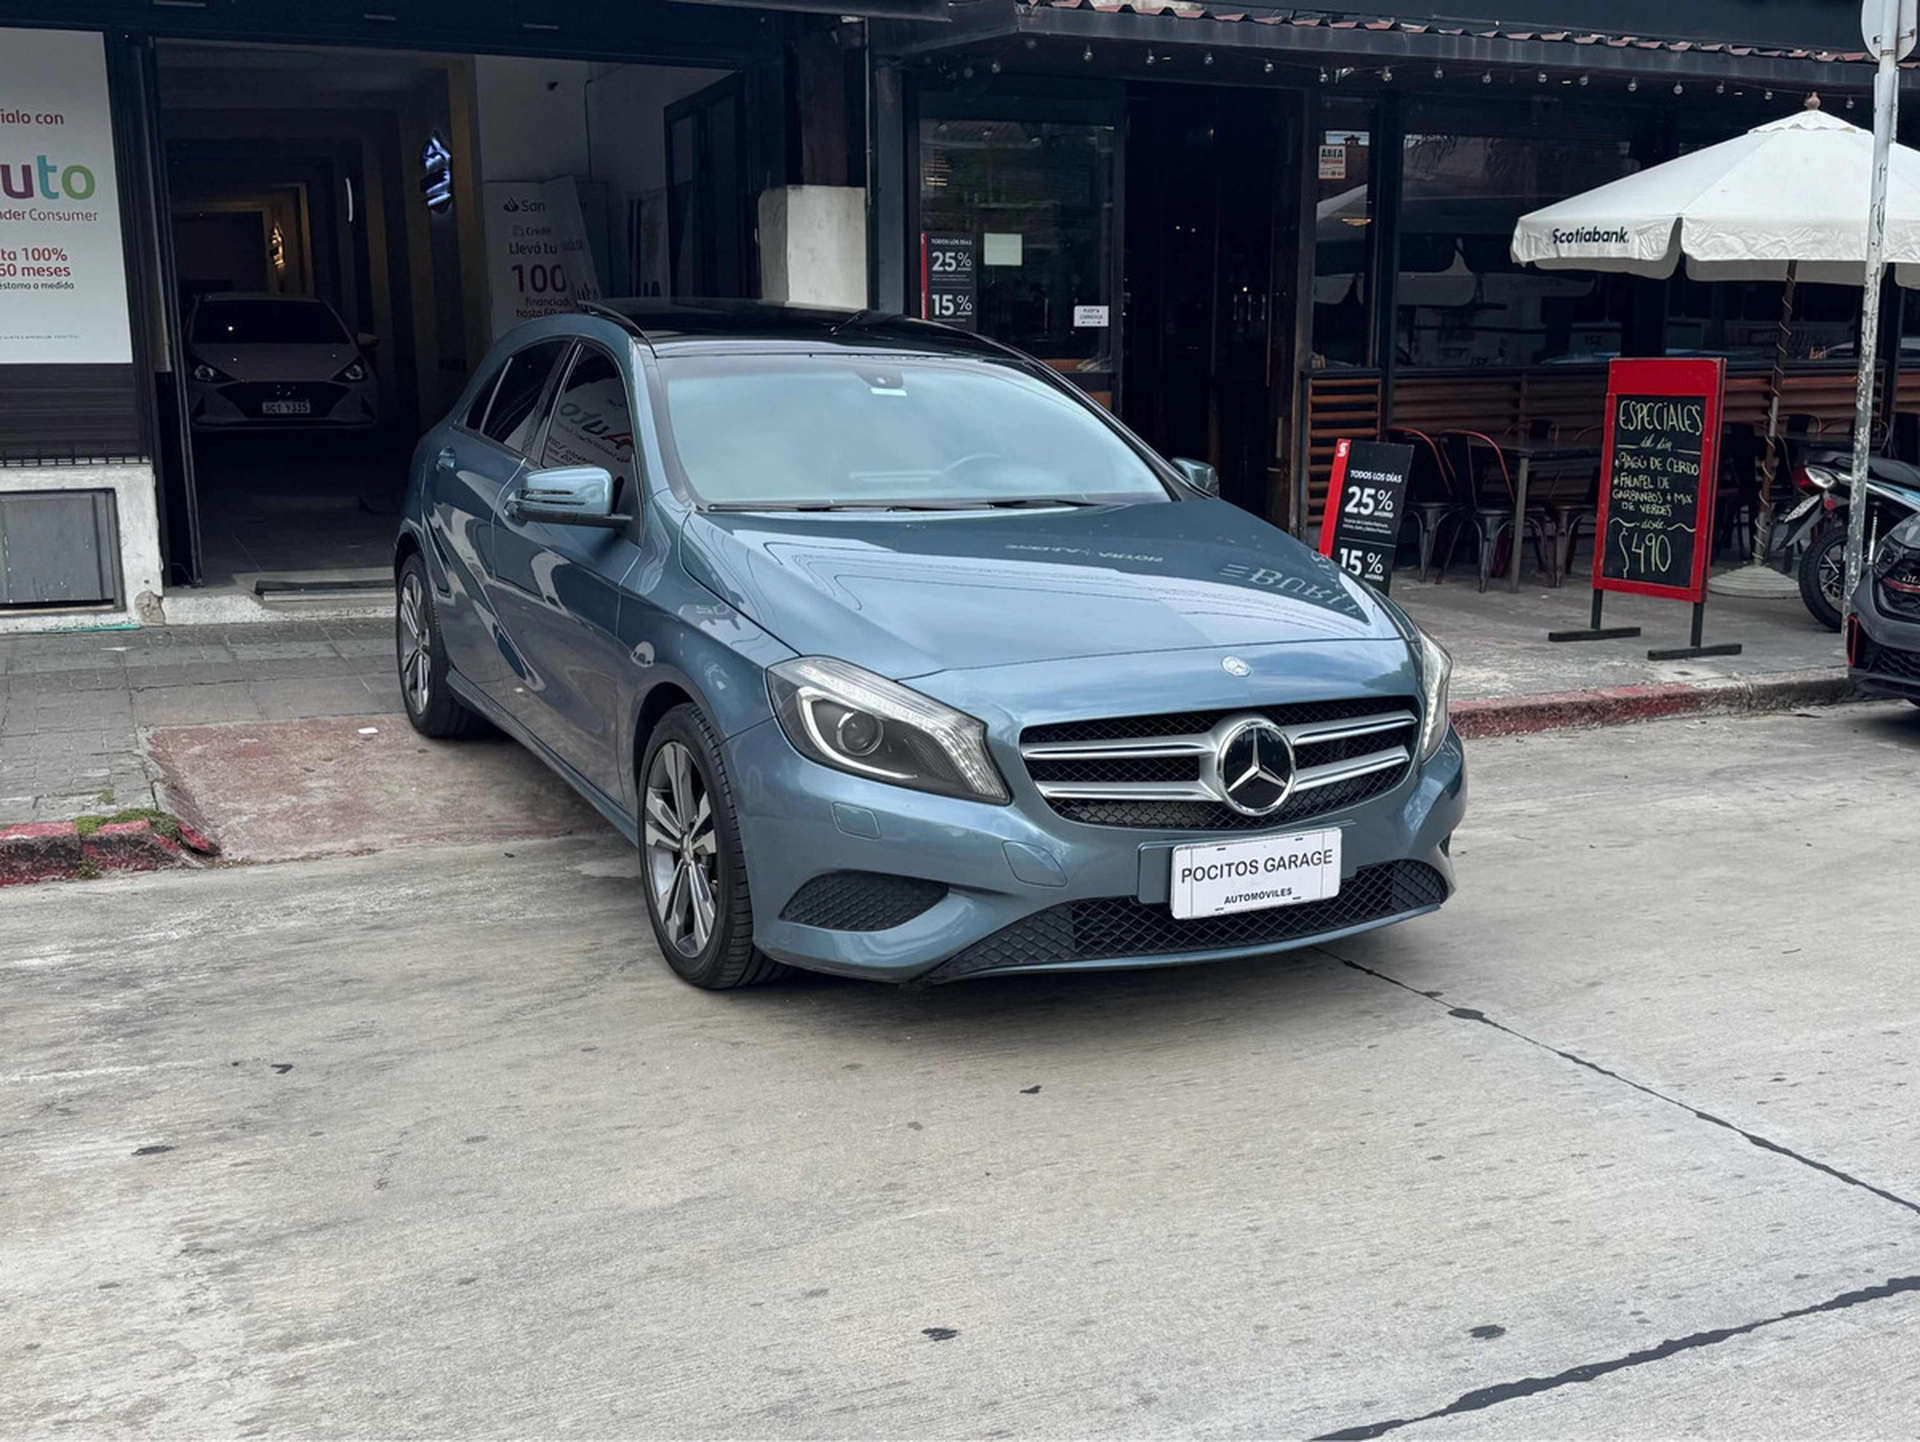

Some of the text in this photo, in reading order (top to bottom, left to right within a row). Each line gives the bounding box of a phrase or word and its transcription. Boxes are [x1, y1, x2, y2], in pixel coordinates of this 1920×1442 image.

[35, 113, 64, 125] con
[29, 208, 98, 221] Consumer
[1552, 226, 1629, 244] Scotiabank
[21, 247, 68, 261] 100%
[932, 251, 972, 272] 25%
[21, 266, 71, 277] meses
[41, 281, 75, 290] medida
[932, 294, 973, 316] 15%
[1650, 457, 1663, 470] DE
[1667, 458, 1699, 476] CERDO
[1350, 470, 1372, 480] TODOS
[1373, 472, 1385, 481] LOS
[1657, 477, 1670, 489] DE
[1344, 485, 1394, 516] 25%
[1621, 502, 1635, 511] DE
[1340, 547, 1384, 577] 15%
[1181, 849, 1333, 884] POCITOS GARAGE
